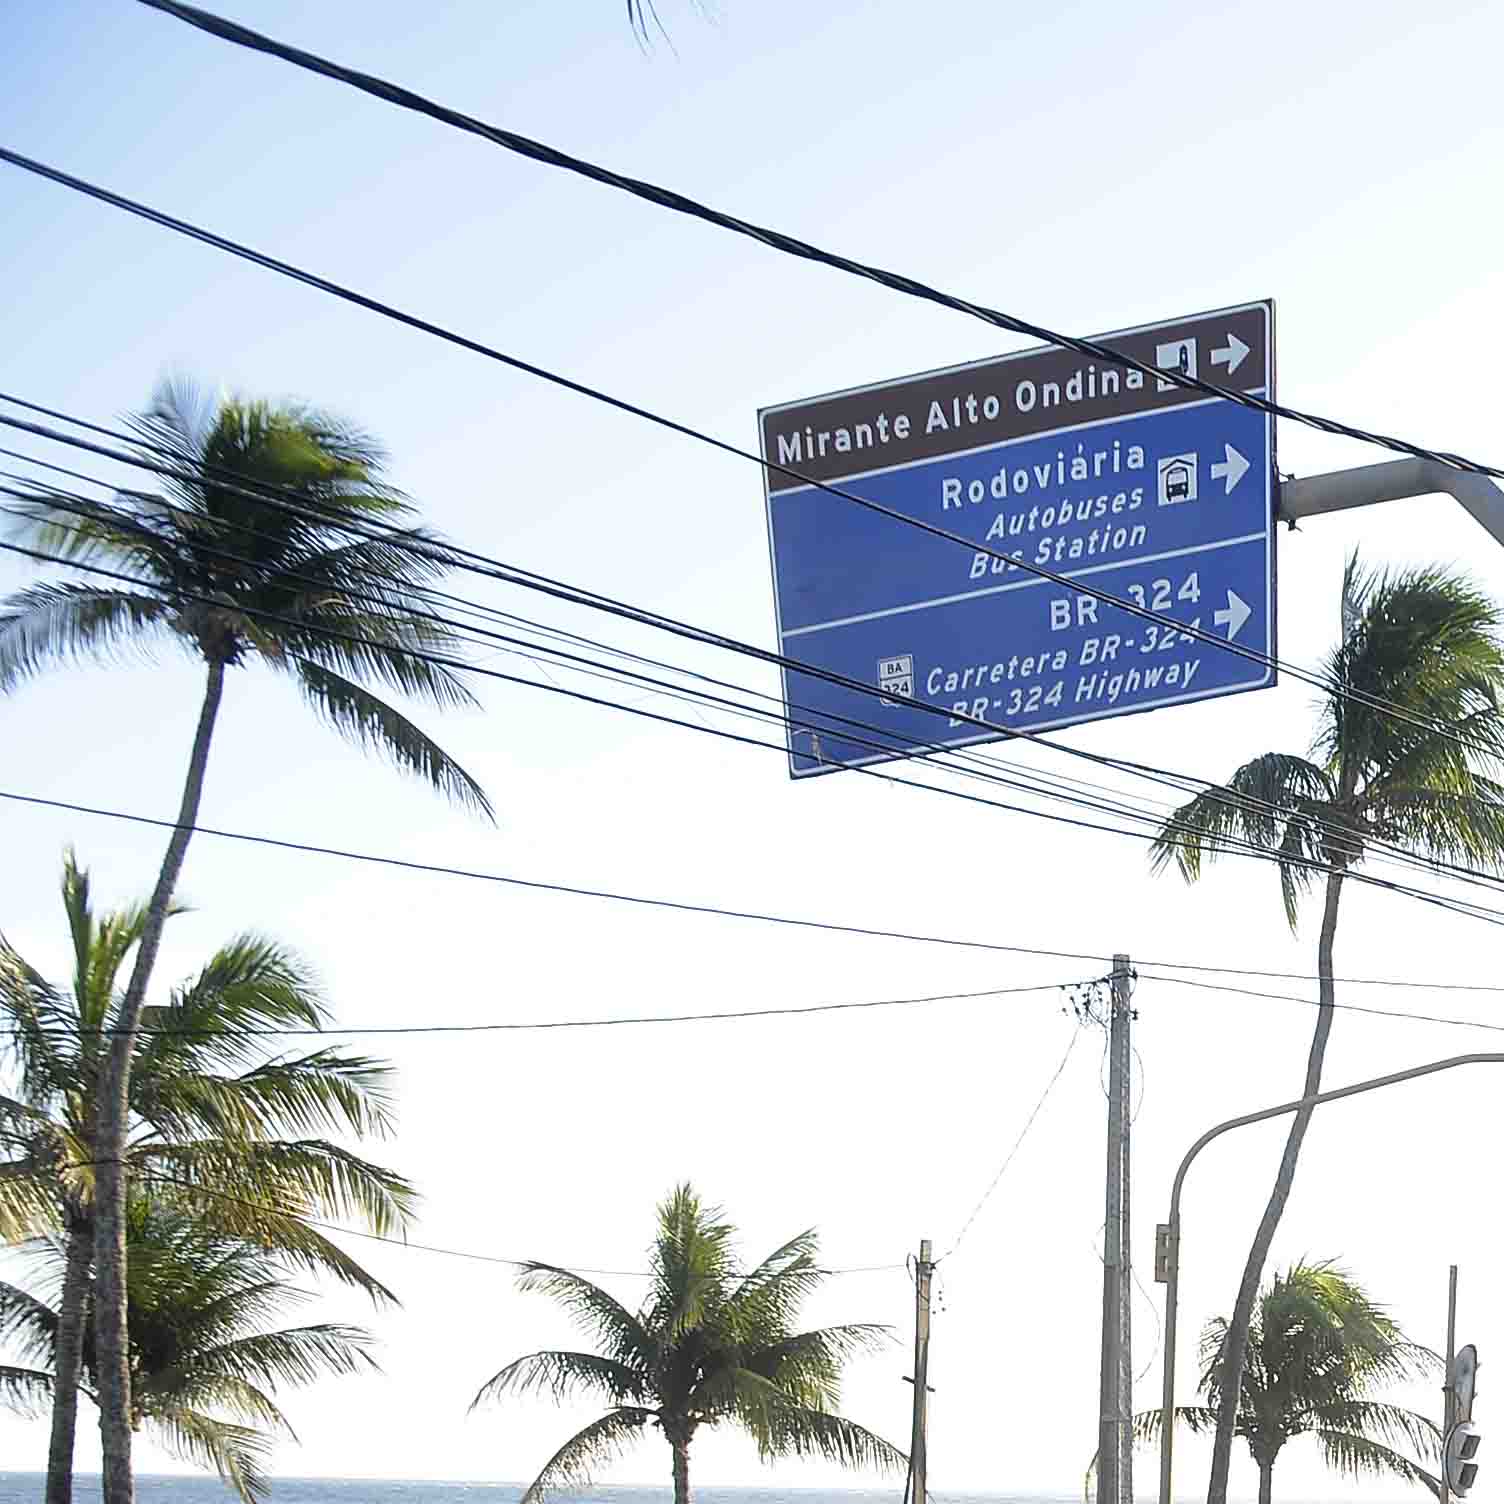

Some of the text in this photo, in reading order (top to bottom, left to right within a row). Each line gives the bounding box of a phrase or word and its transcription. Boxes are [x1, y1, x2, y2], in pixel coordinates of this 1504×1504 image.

[777, 365, 1144, 465] Mirante Alto Ondina
[942, 440, 1145, 510] Rodoviária
[986, 487, 1144, 541] Autobuses
[969, 523, 1147, 579] Bus Station
[1050, 571, 1201, 631] BR324
[887, 662, 903, 675] BA
[927, 616, 1201, 696] Carretera BR-324
[948, 658, 1201, 728] BR-324 Highway
